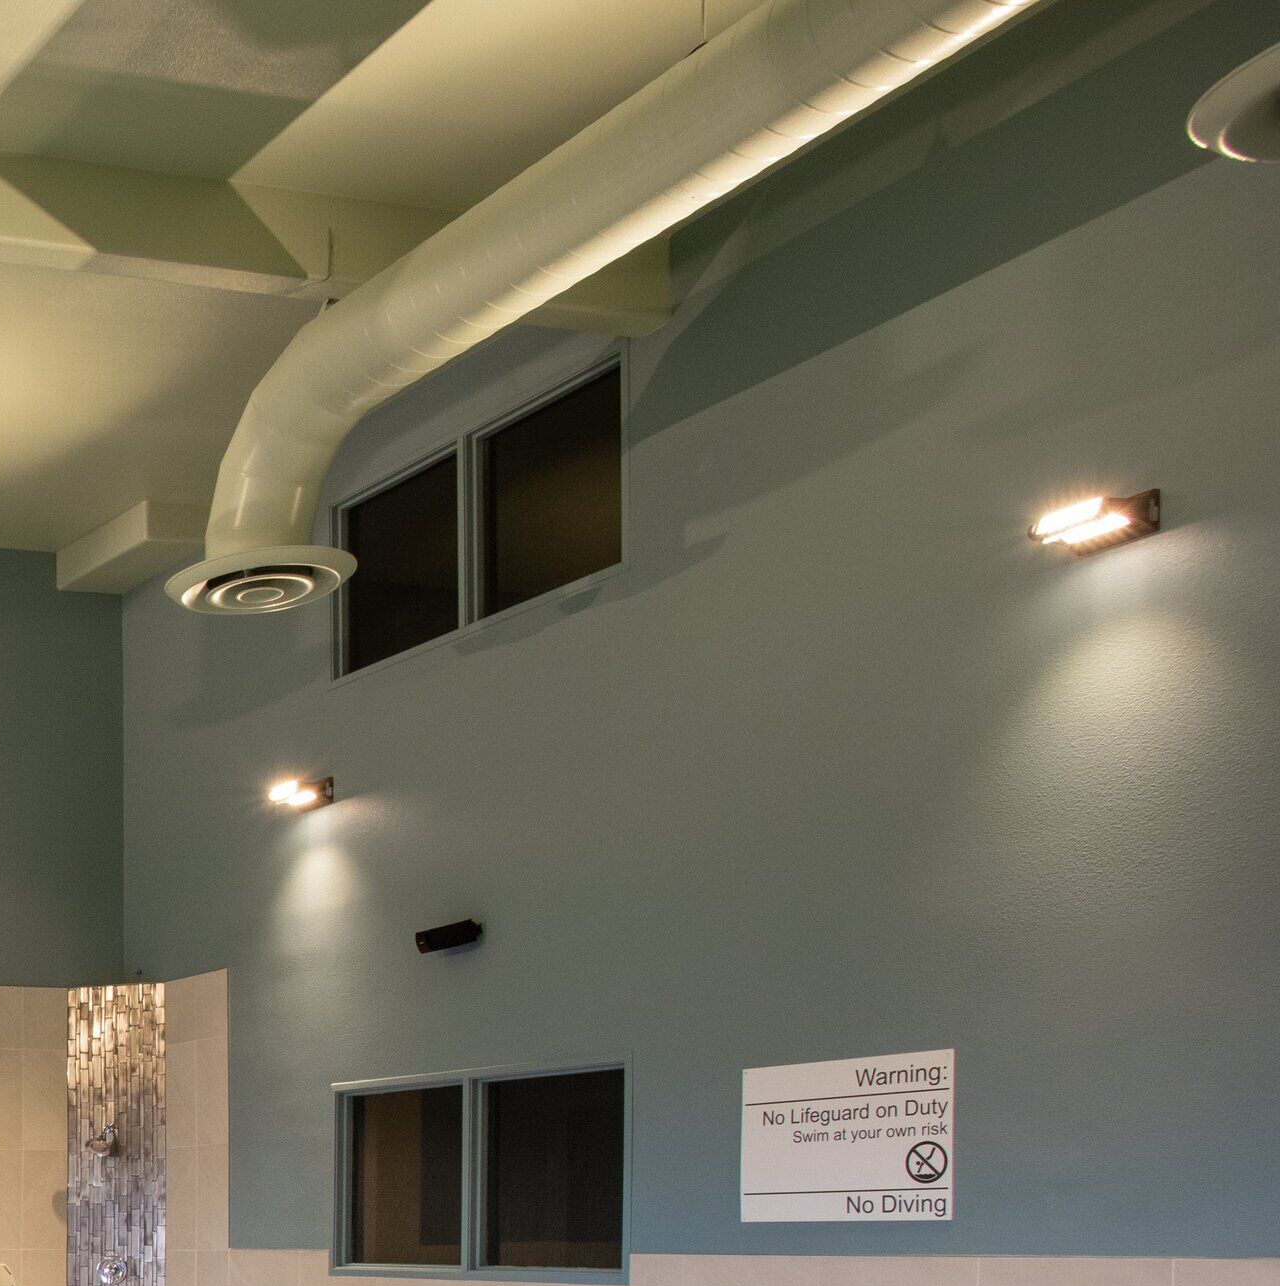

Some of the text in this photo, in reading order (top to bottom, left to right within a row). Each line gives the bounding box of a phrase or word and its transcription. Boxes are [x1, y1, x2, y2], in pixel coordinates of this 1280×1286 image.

[855, 1064, 948, 1088] Warning:
[762, 1099, 948, 1127] No Lifeguard on Duty
[793, 1122, 948, 1144] Swim at your own risk
[846, 1194, 947, 1217] No Diving
